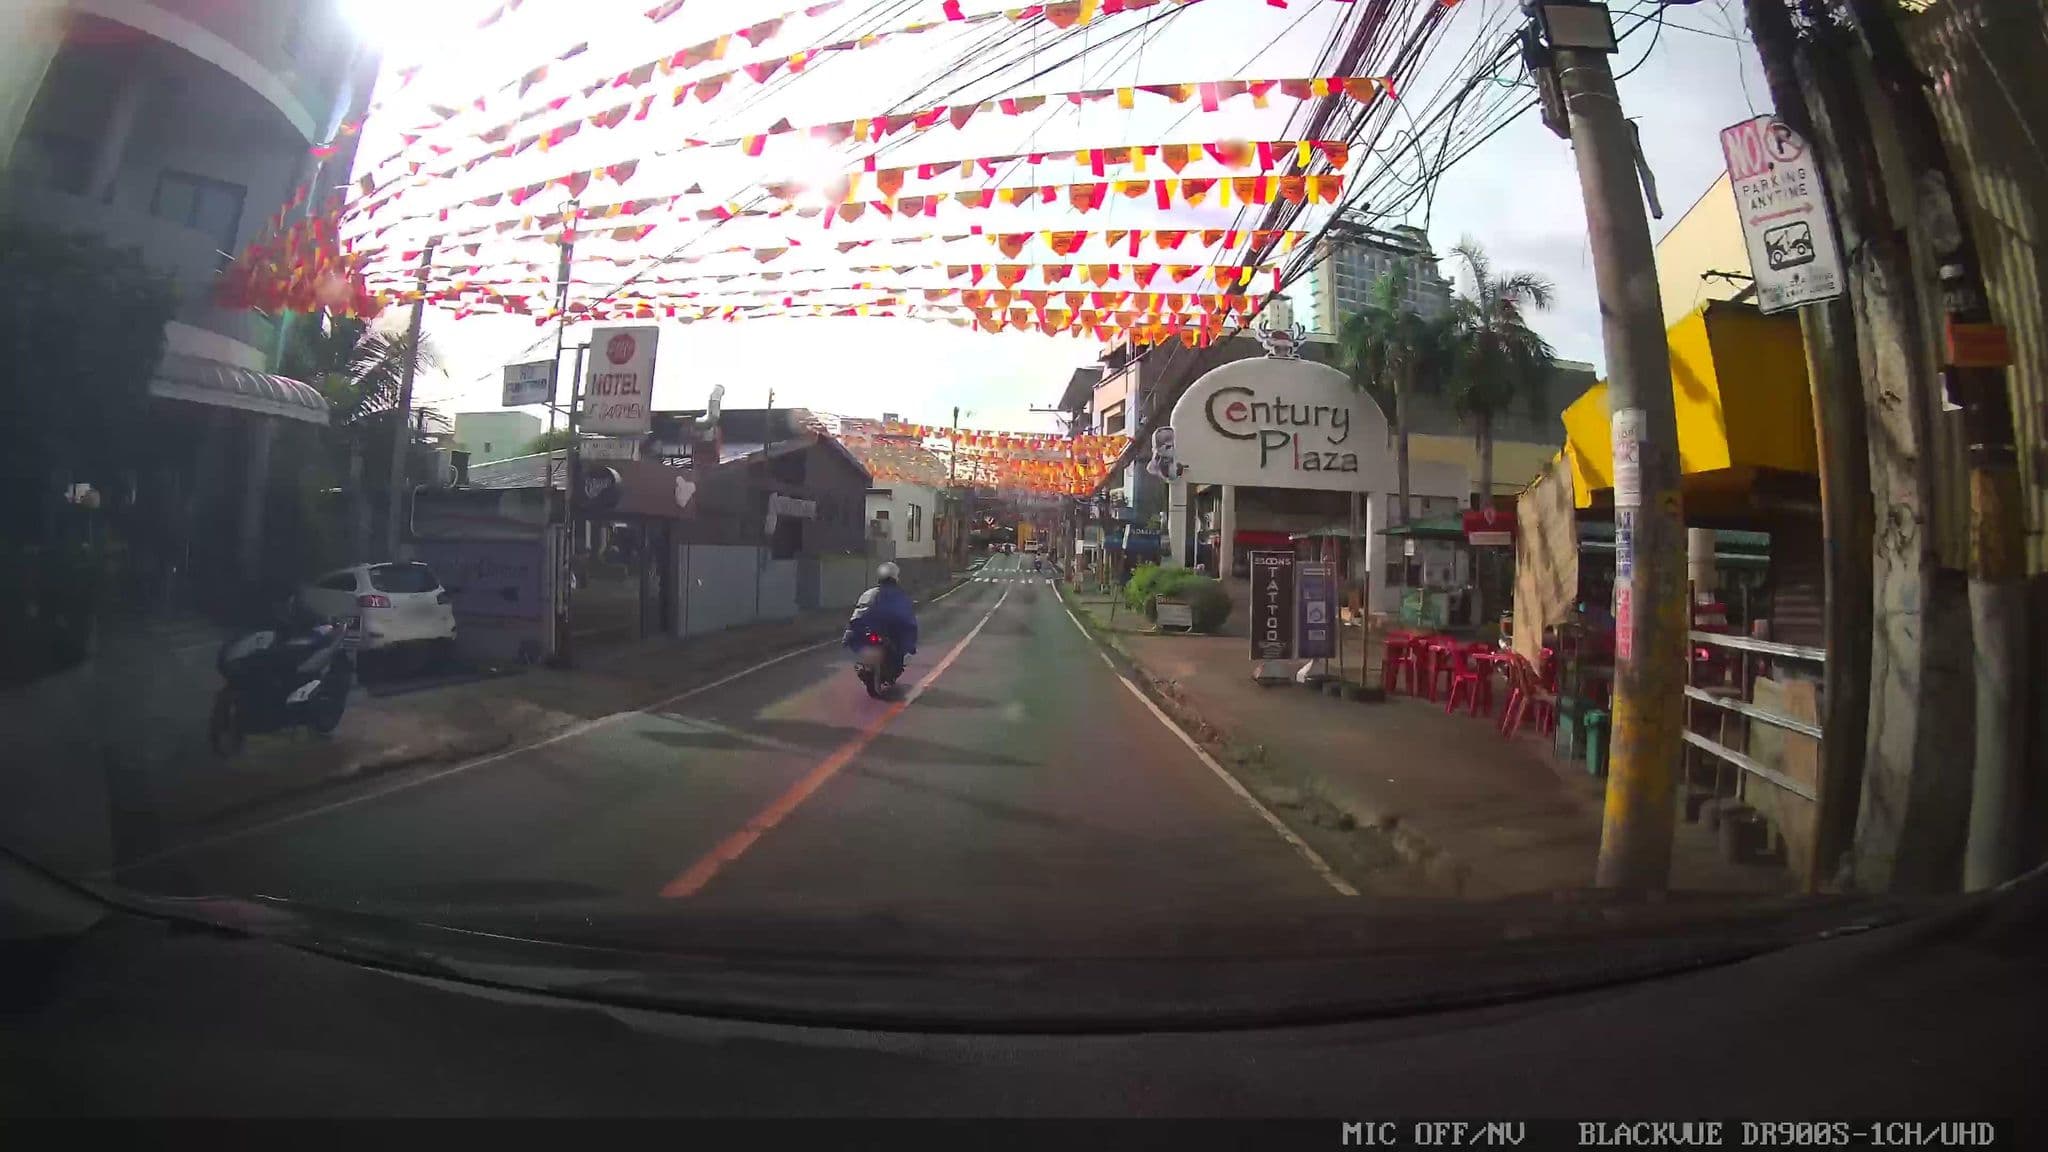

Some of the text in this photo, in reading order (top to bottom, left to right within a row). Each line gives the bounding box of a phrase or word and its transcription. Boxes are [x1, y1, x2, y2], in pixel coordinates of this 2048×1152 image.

[1726, 122, 1768, 179] NO
[1743, 168, 1807, 195] PARKING
[1751, 183, 1808, 210] ANYTIME
[1205, 386, 1349, 445] Century
[1260, 429, 1358, 473] Plaza
[1266, 566, 1279, 641] TATTOO
